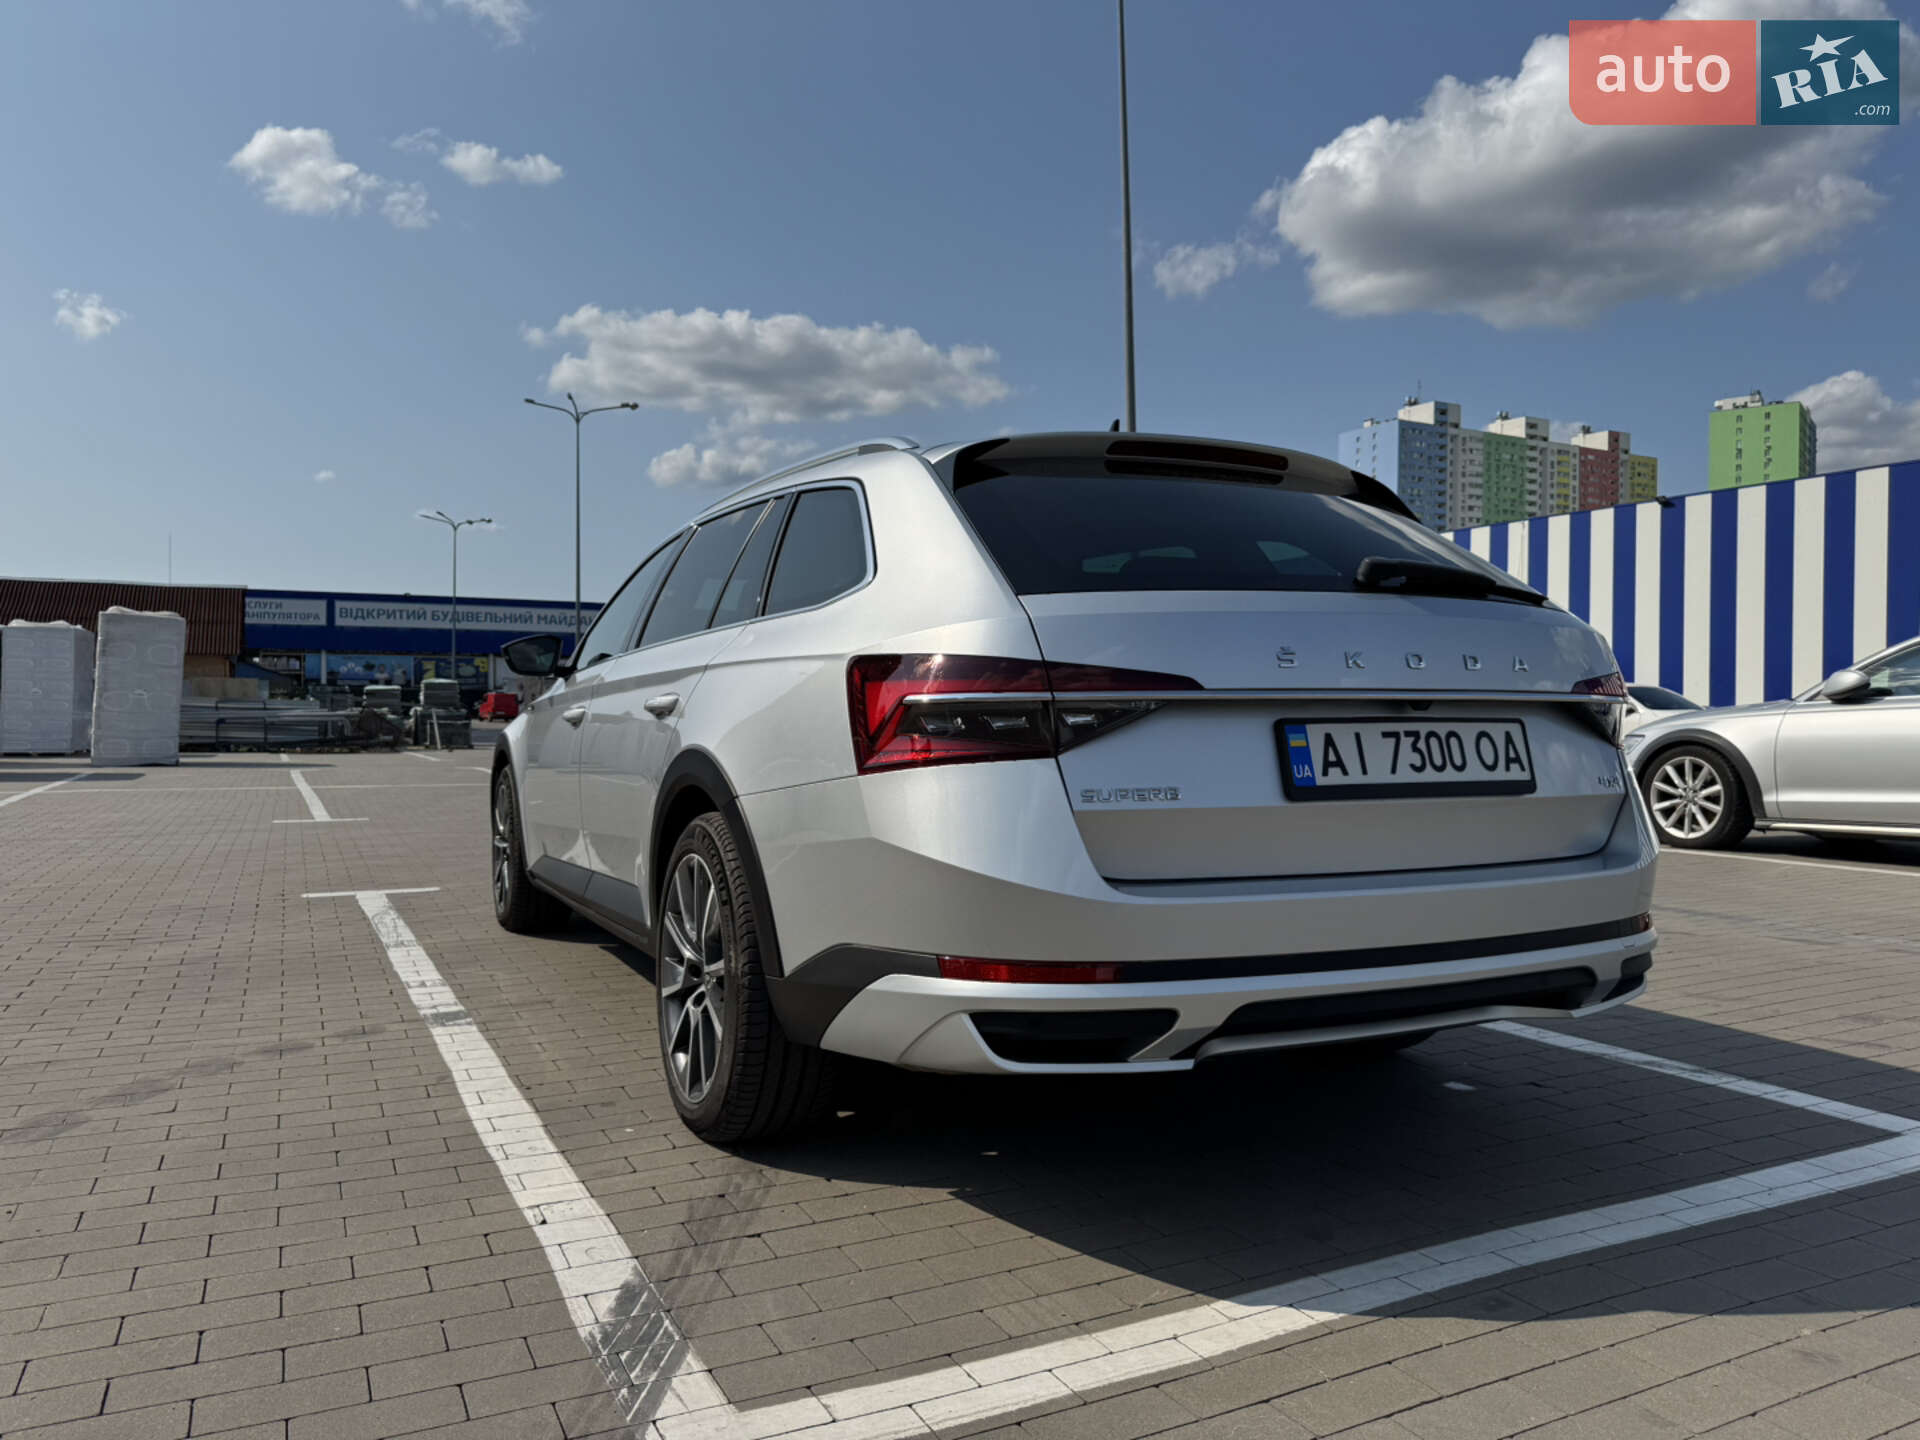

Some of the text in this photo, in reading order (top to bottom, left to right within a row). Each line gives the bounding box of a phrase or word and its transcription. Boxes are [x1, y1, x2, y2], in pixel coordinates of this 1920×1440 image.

[338, 605, 427, 621] ВІДКРИТИЙ
[431, 607, 534, 625] БУДІВЕЛЬНИЙ
[1321, 730, 1526, 777] AI 7300 OA
[1293, 764, 1313, 779] UA
[1080, 786, 1181, 804] SUPERB
